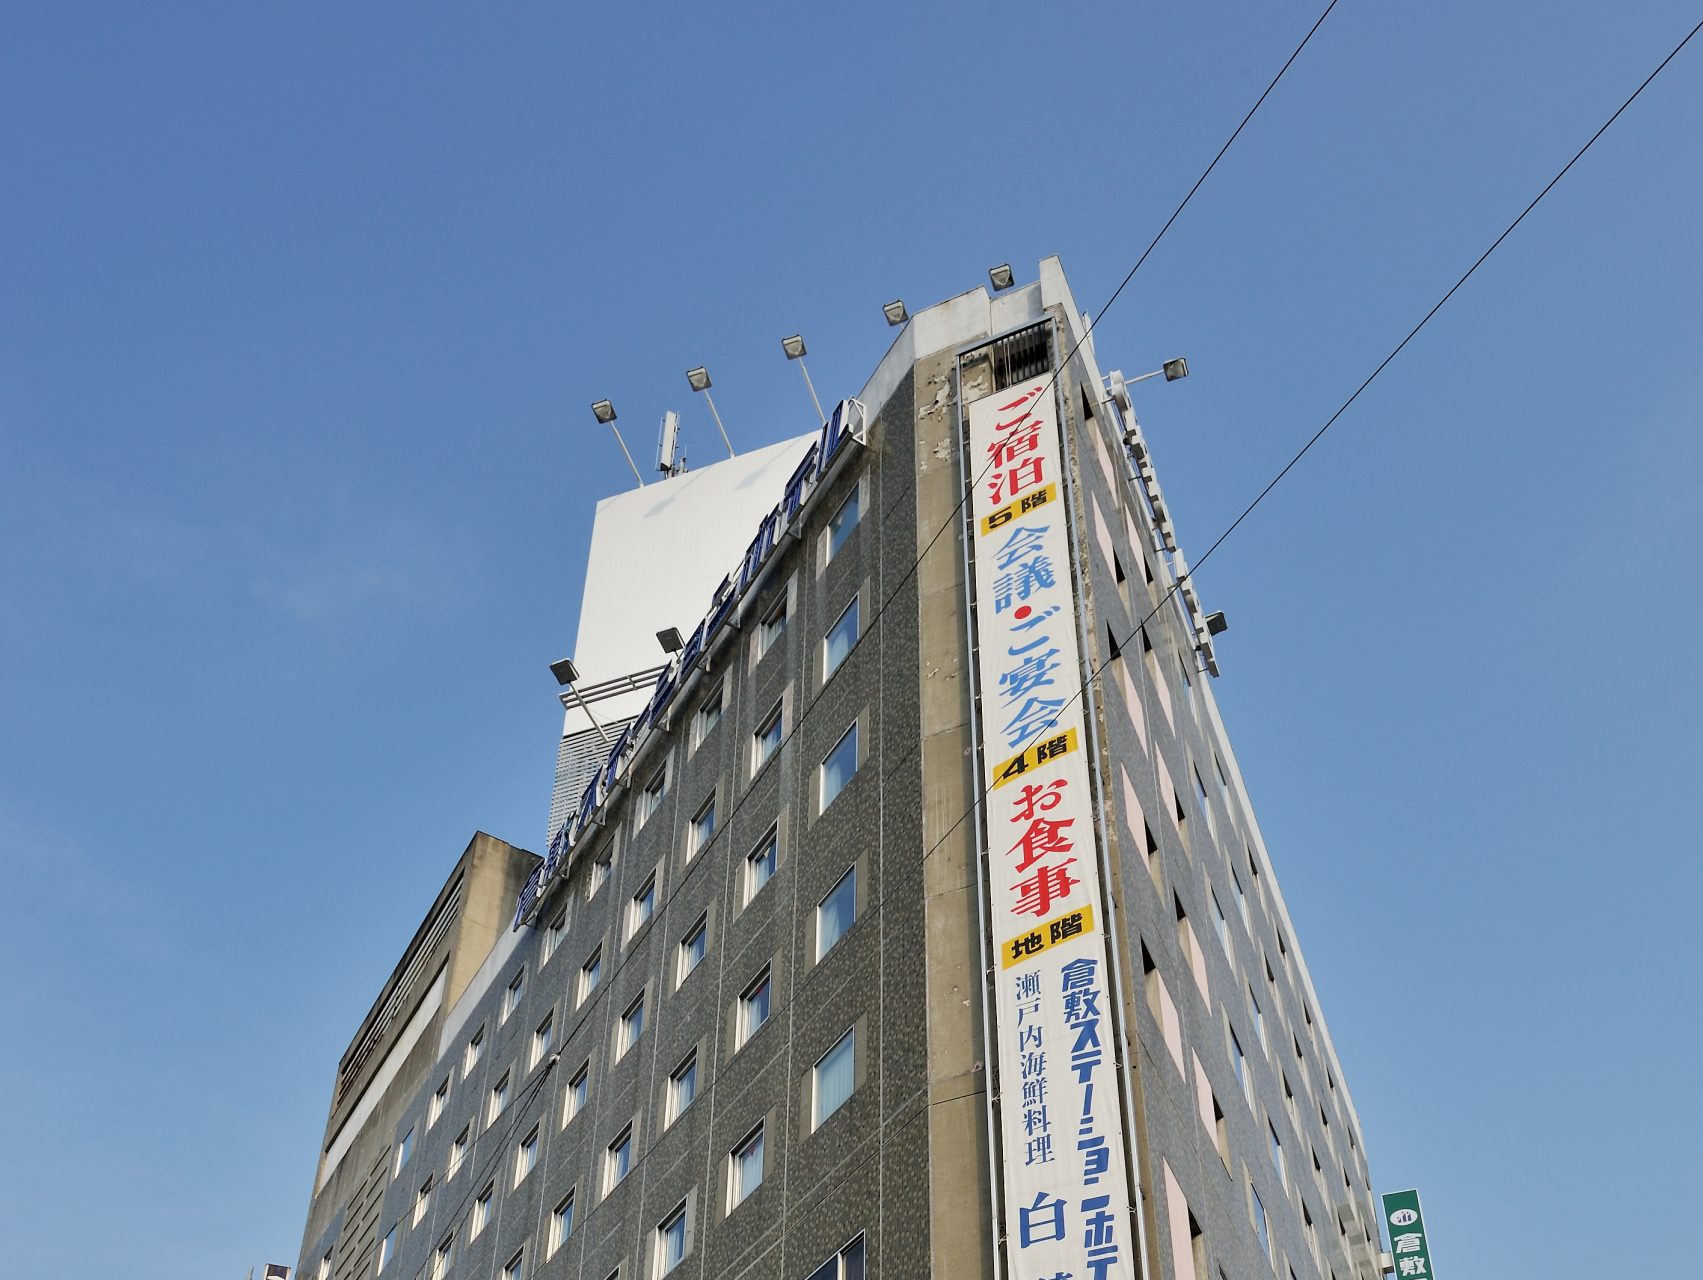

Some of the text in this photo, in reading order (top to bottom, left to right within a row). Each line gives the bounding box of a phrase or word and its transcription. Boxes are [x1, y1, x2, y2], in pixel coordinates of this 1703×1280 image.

[987, 386, 1044, 505] ご宿泊
[988, 490, 1048, 528] 5階
[1001, 736, 1068, 778] 4階
[1006, 778, 1080, 918] お食事
[1011, 911, 1083, 958] 地階
[1015, 969, 1055, 1166] 瀬戸内海鮮料理
